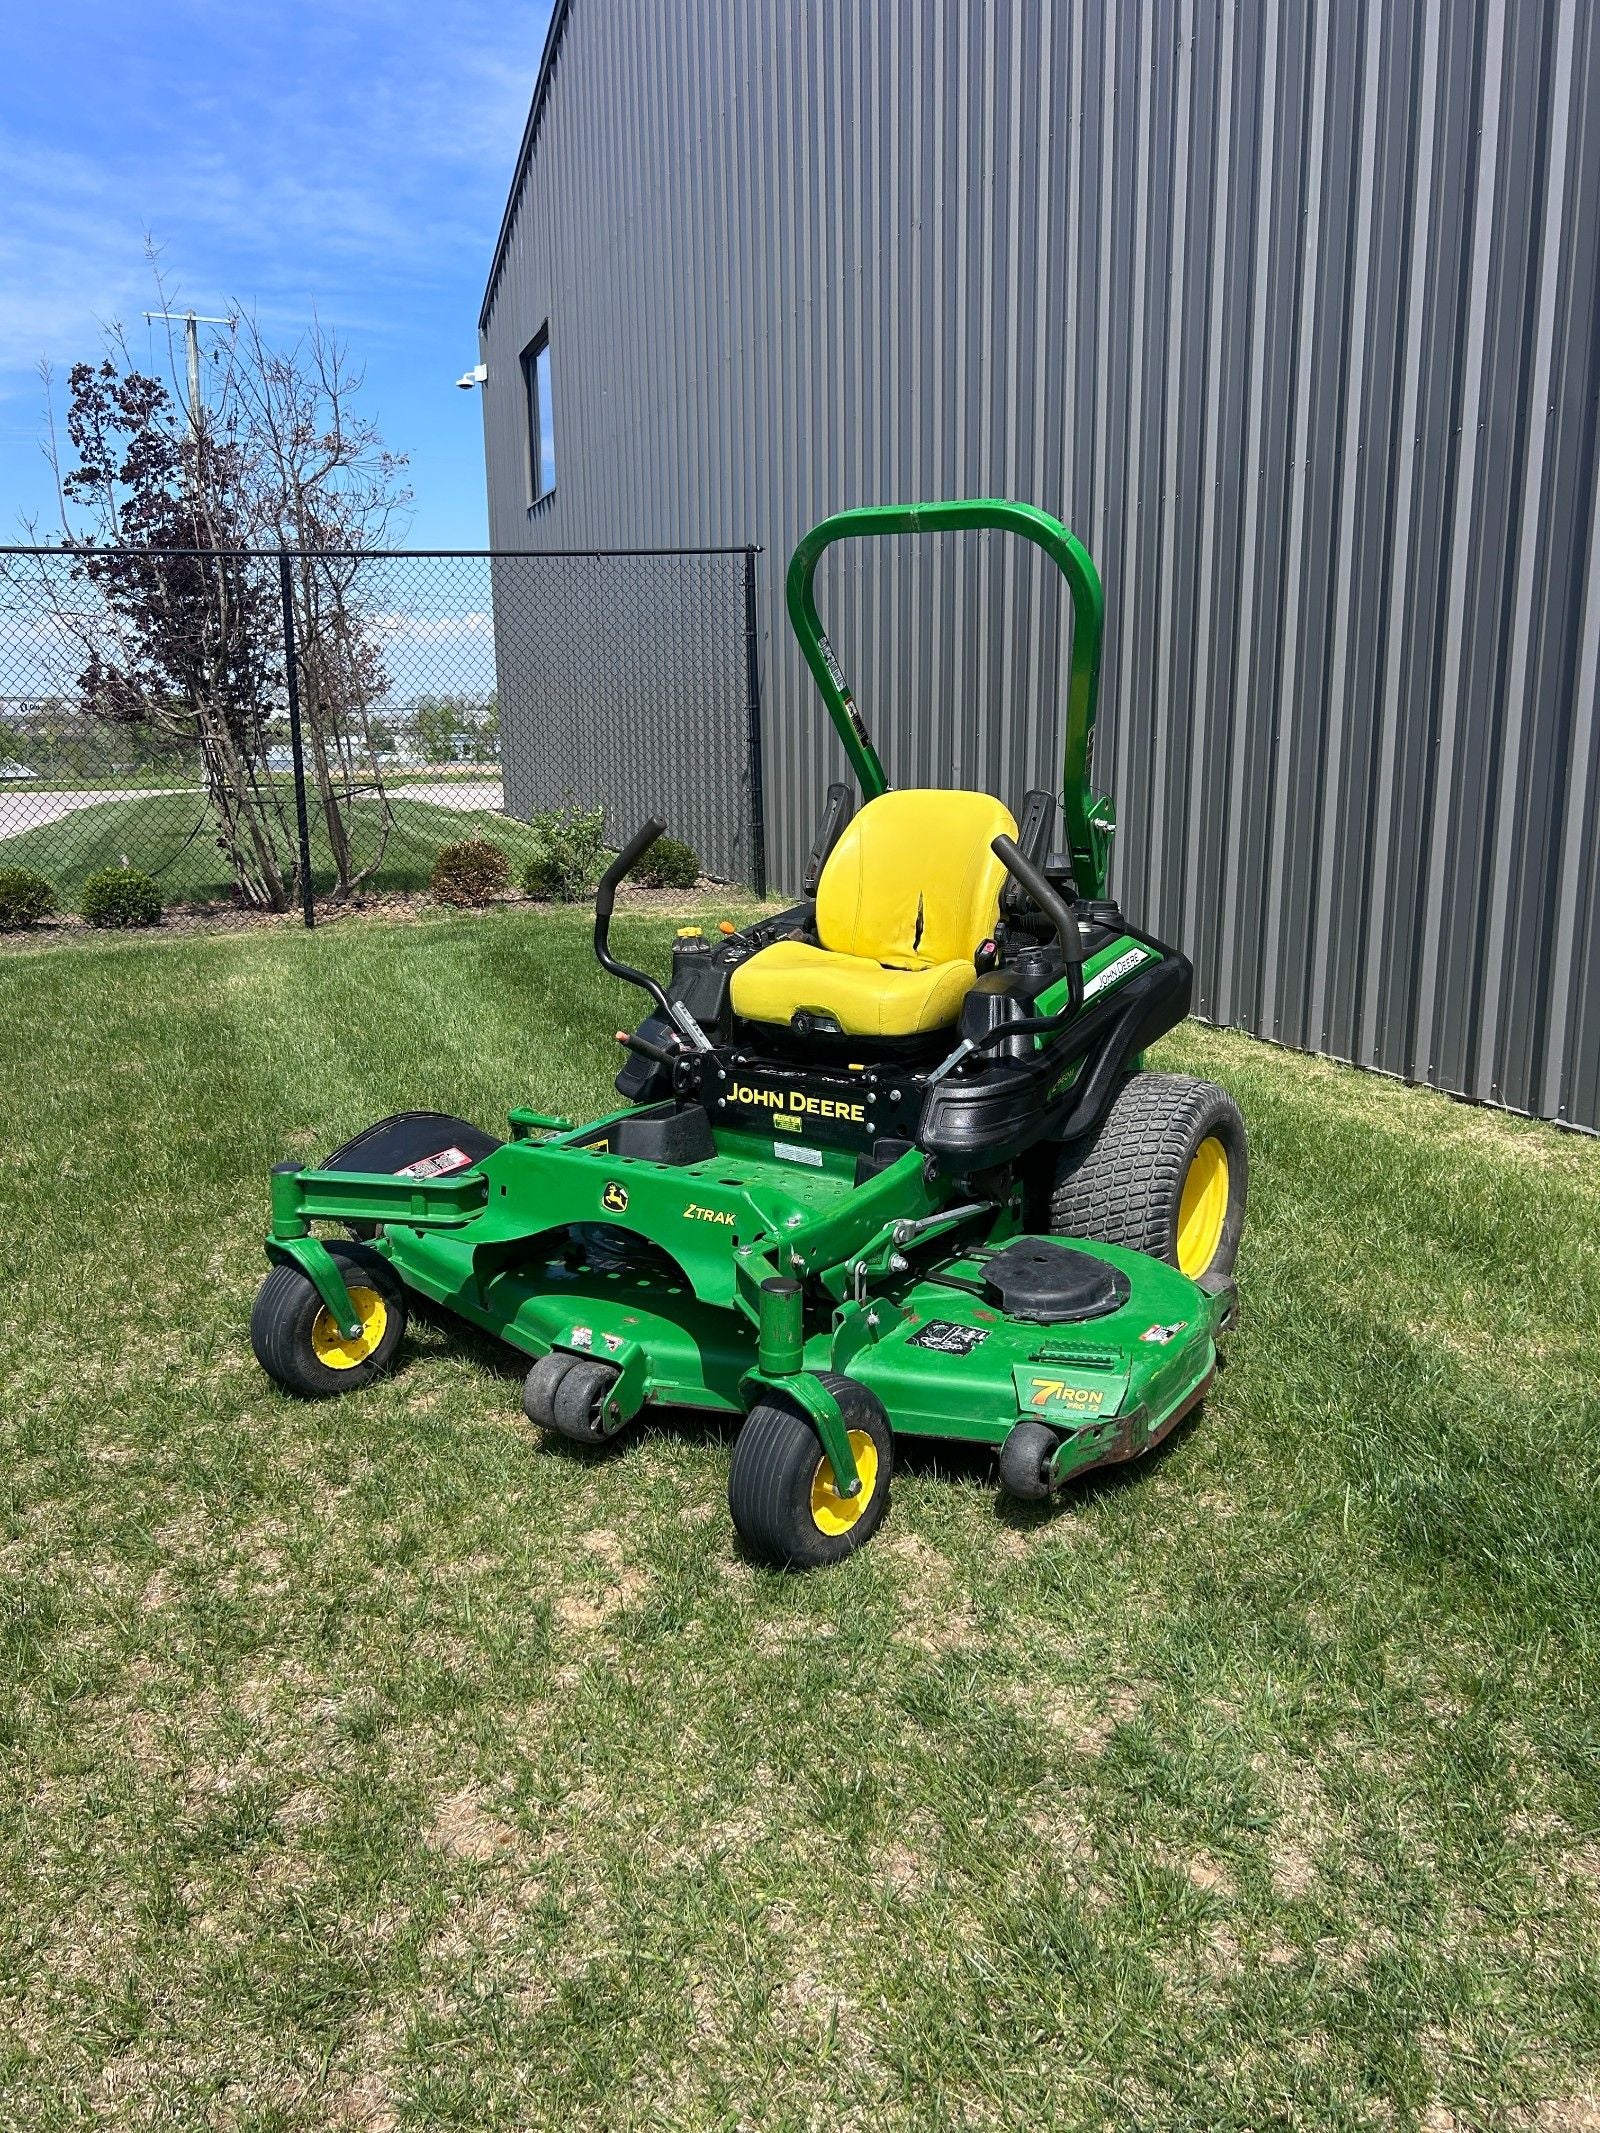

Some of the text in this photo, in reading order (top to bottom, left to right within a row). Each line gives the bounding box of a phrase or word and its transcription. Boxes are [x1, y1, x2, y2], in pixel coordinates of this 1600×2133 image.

[1099, 952, 1139, 988] JOHN DEERE
[726, 1083, 865, 1122] JOHN DEERE
[683, 1203, 737, 1226] ZTRAK
